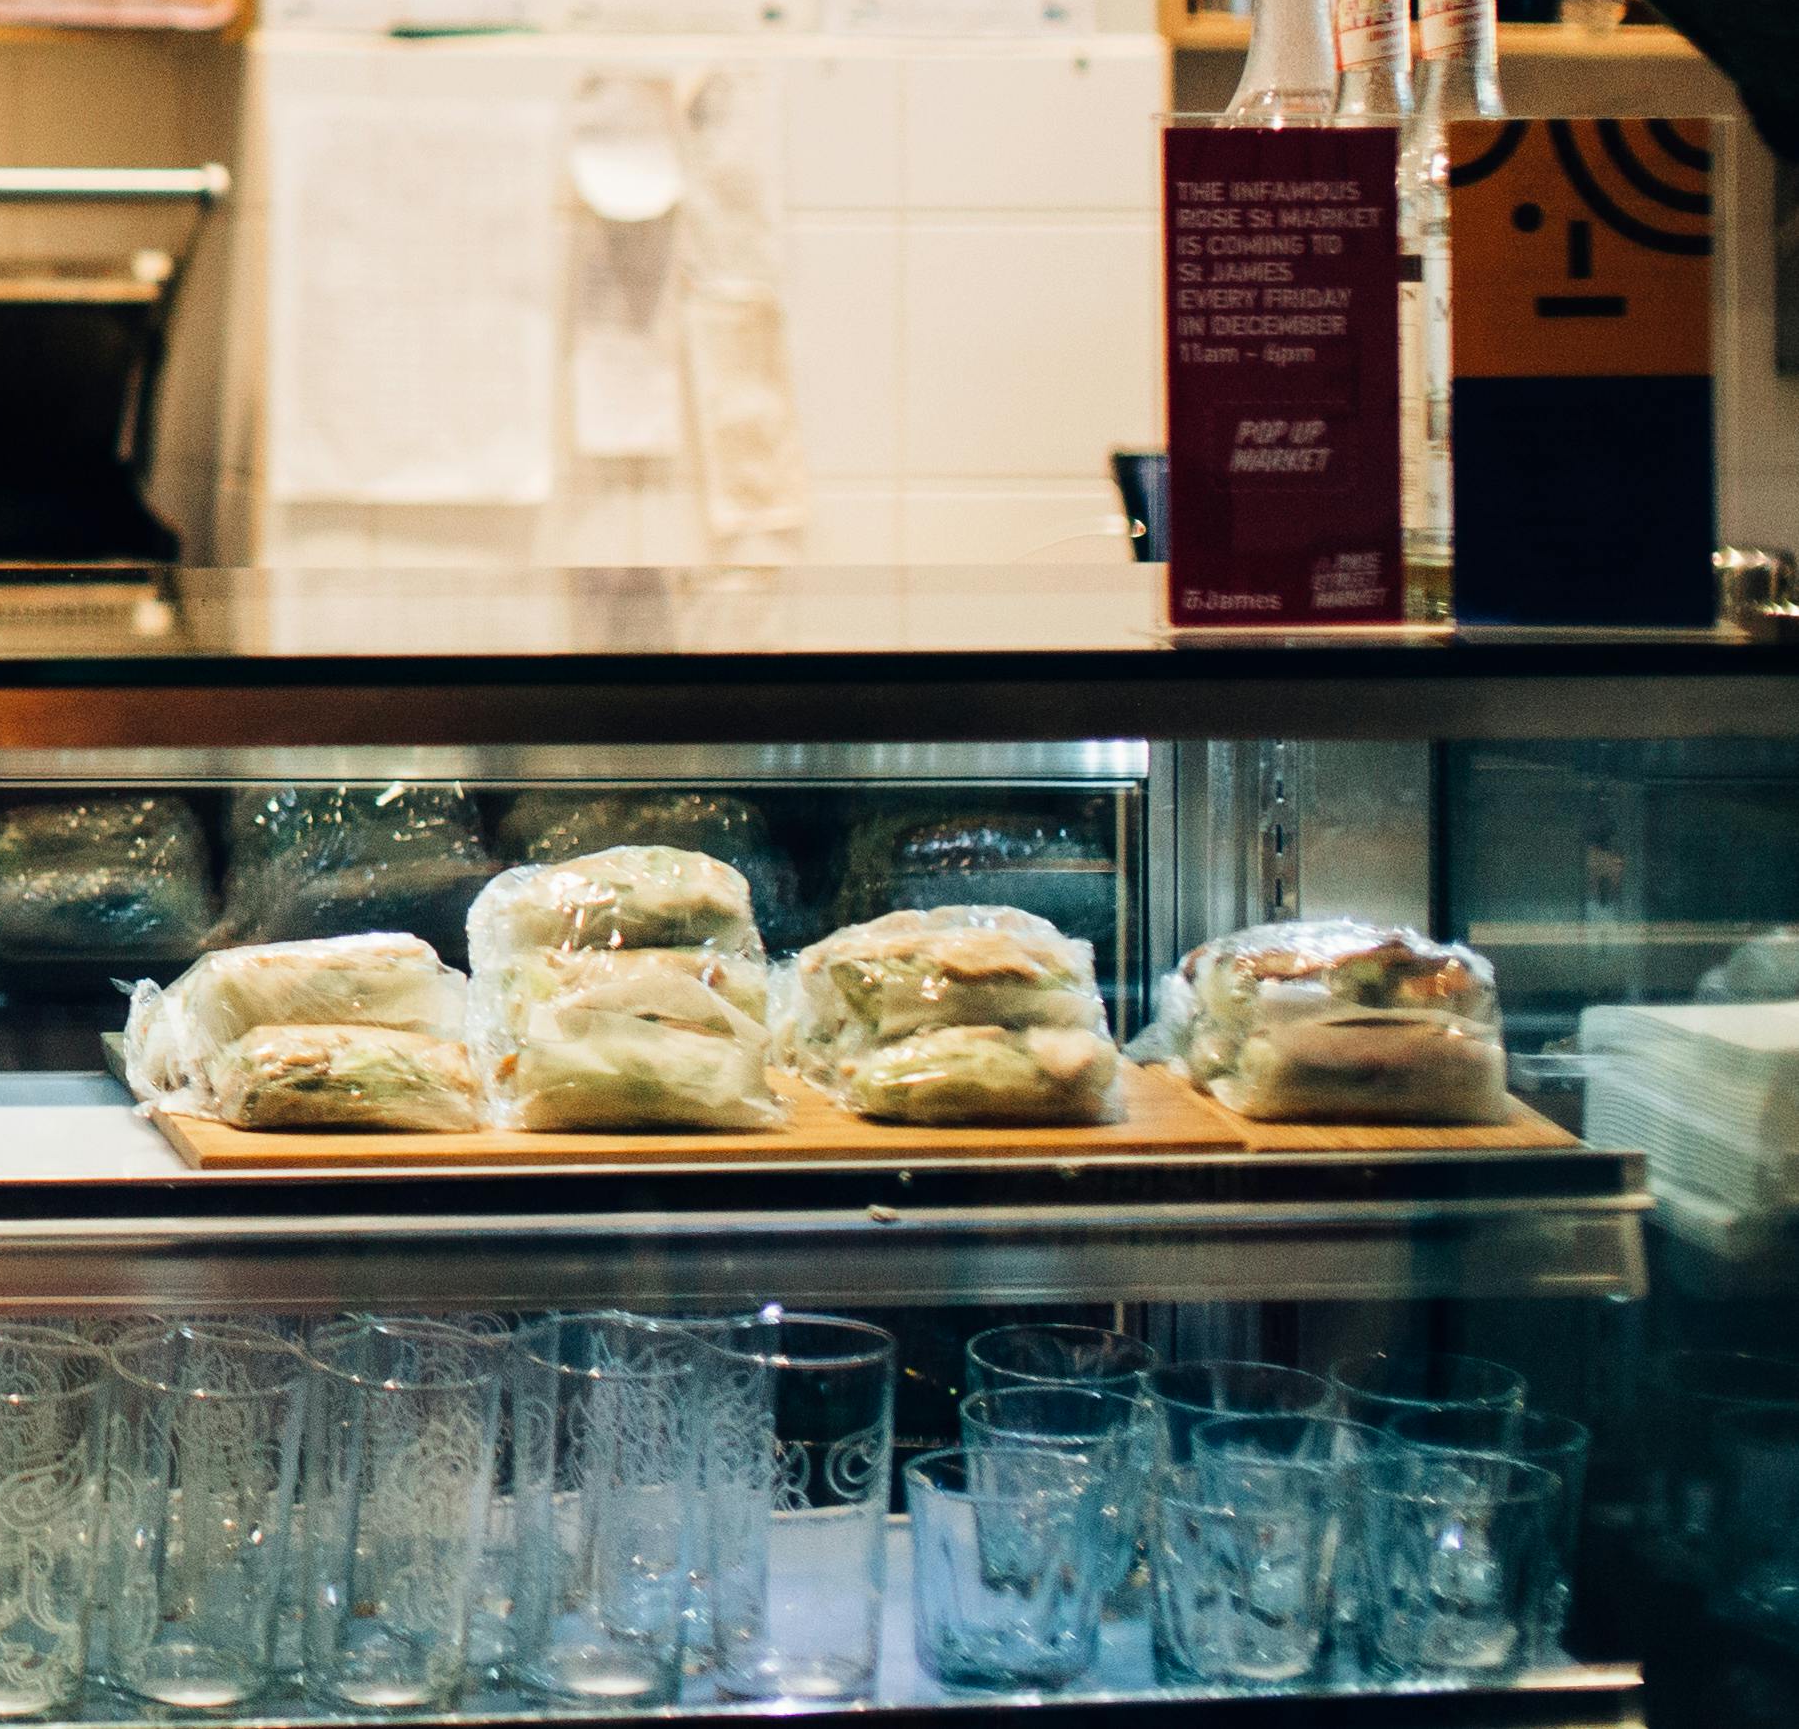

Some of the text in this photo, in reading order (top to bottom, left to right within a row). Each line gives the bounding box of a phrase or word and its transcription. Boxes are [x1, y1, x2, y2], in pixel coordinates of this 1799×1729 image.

[1176, 181, 1362, 201] THE INFAMOUS
[1176, 208, 1242, 229] ROSE
[1277, 207, 1383, 228] MARKET
[1176, 234, 1343, 255] IS COMING TO
[1209, 262, 1295, 283] JAMES
[1176, 288, 1352, 309] EVERY FRIDAY
[1176, 315, 1348, 336] IN DECEMBER
[1179, 342, 1240, 362] 11am
[1229, 448, 1334, 472] MARKET
